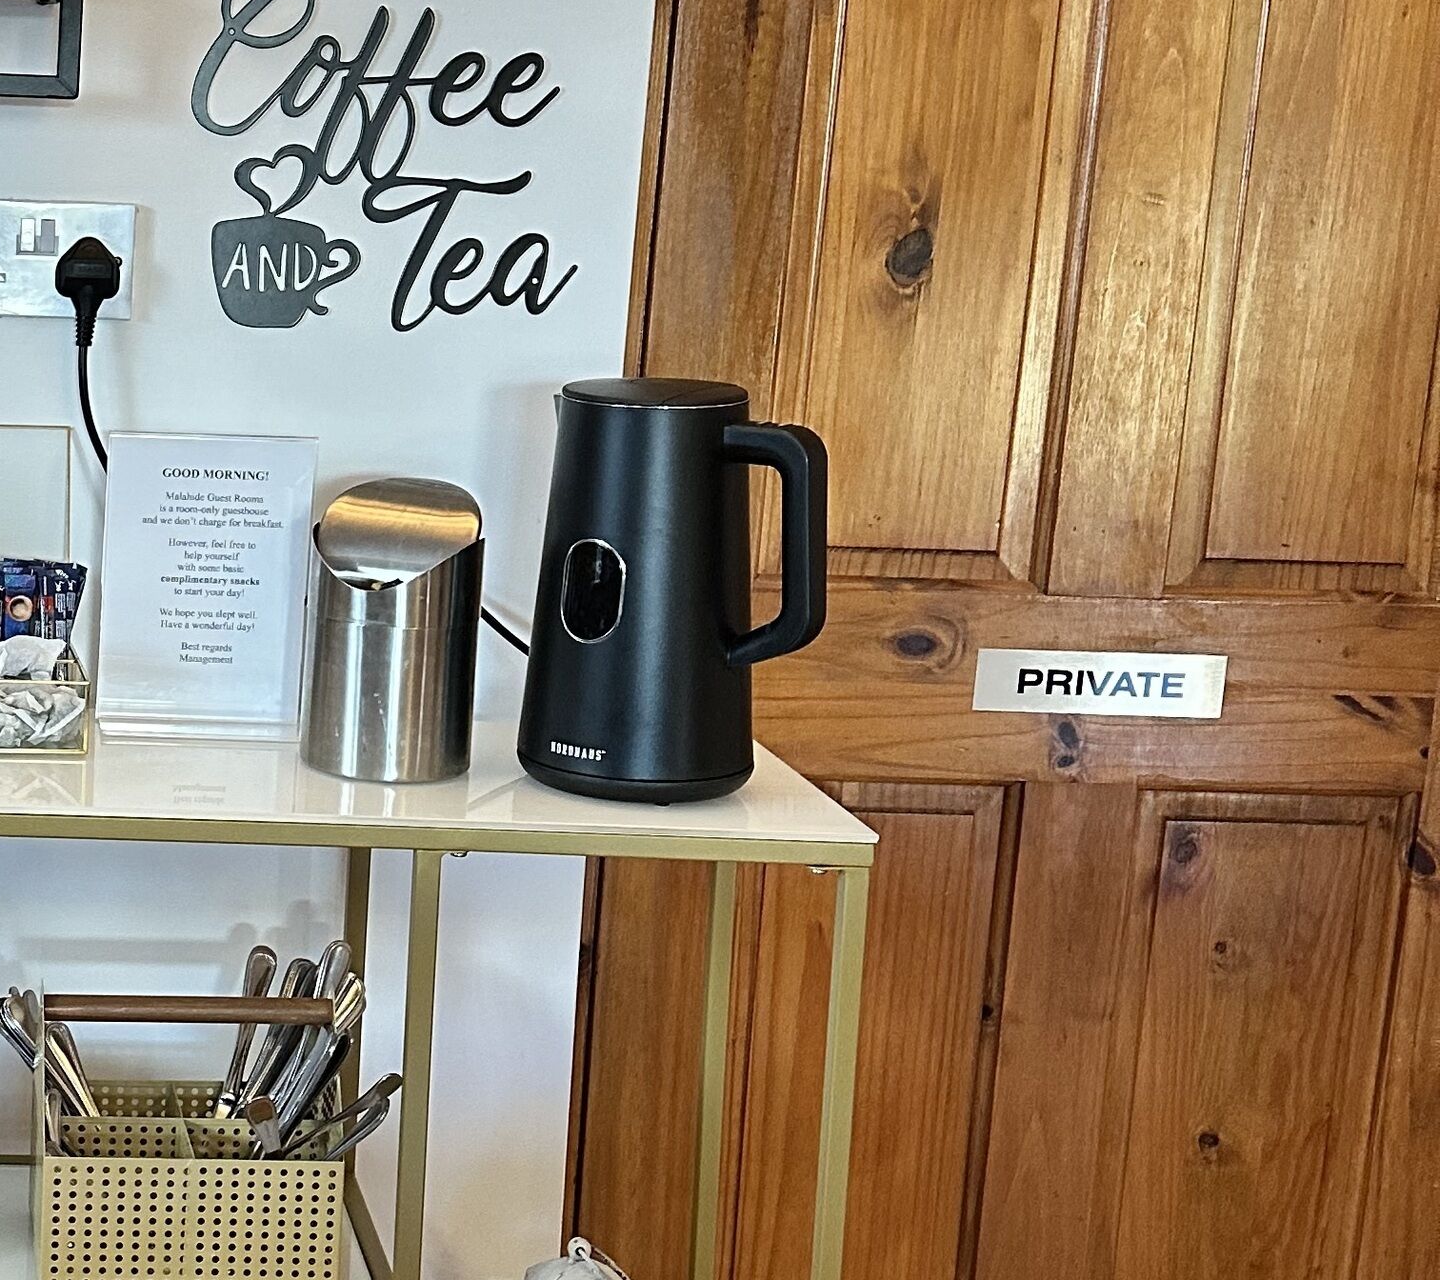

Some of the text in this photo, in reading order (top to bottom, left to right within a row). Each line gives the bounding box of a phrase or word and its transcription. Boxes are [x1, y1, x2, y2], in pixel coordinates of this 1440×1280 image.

[361, 170, 578, 332] Tea
[221, 242, 318, 292] AND
[162, 467, 270, 481] GOOD MORNING!
[165, 491, 264, 503] Malahide Guest Rooms
[159, 504, 166, 512] is
[176, 506, 220, 516] room-only
[222, 506, 269, 517] guesthouse
[142, 516, 158, 524] and
[198, 517, 227, 528] charge
[229, 517, 242, 527] for
[168, 538, 256, 549] However, feel free to
[184, 550, 240, 562] help yourself
[177, 562, 244, 573] with some basic
[160, 575, 260, 586] complimentary snacks
[174, 587, 245, 598] to start your day!
[159, 607, 173, 616] We
[174, 608, 195, 619] hope
[197, 610, 213, 619] you
[215, 609, 235, 620] slept
[160, 619, 182, 628] Have
[192, 621, 234, 631] wonderful
[236, 622, 255, 632] day!
[181, 642, 232, 653] Best regards
[179, 654, 233, 664] Management
[1016, 667, 1186, 699] PRIVATE
